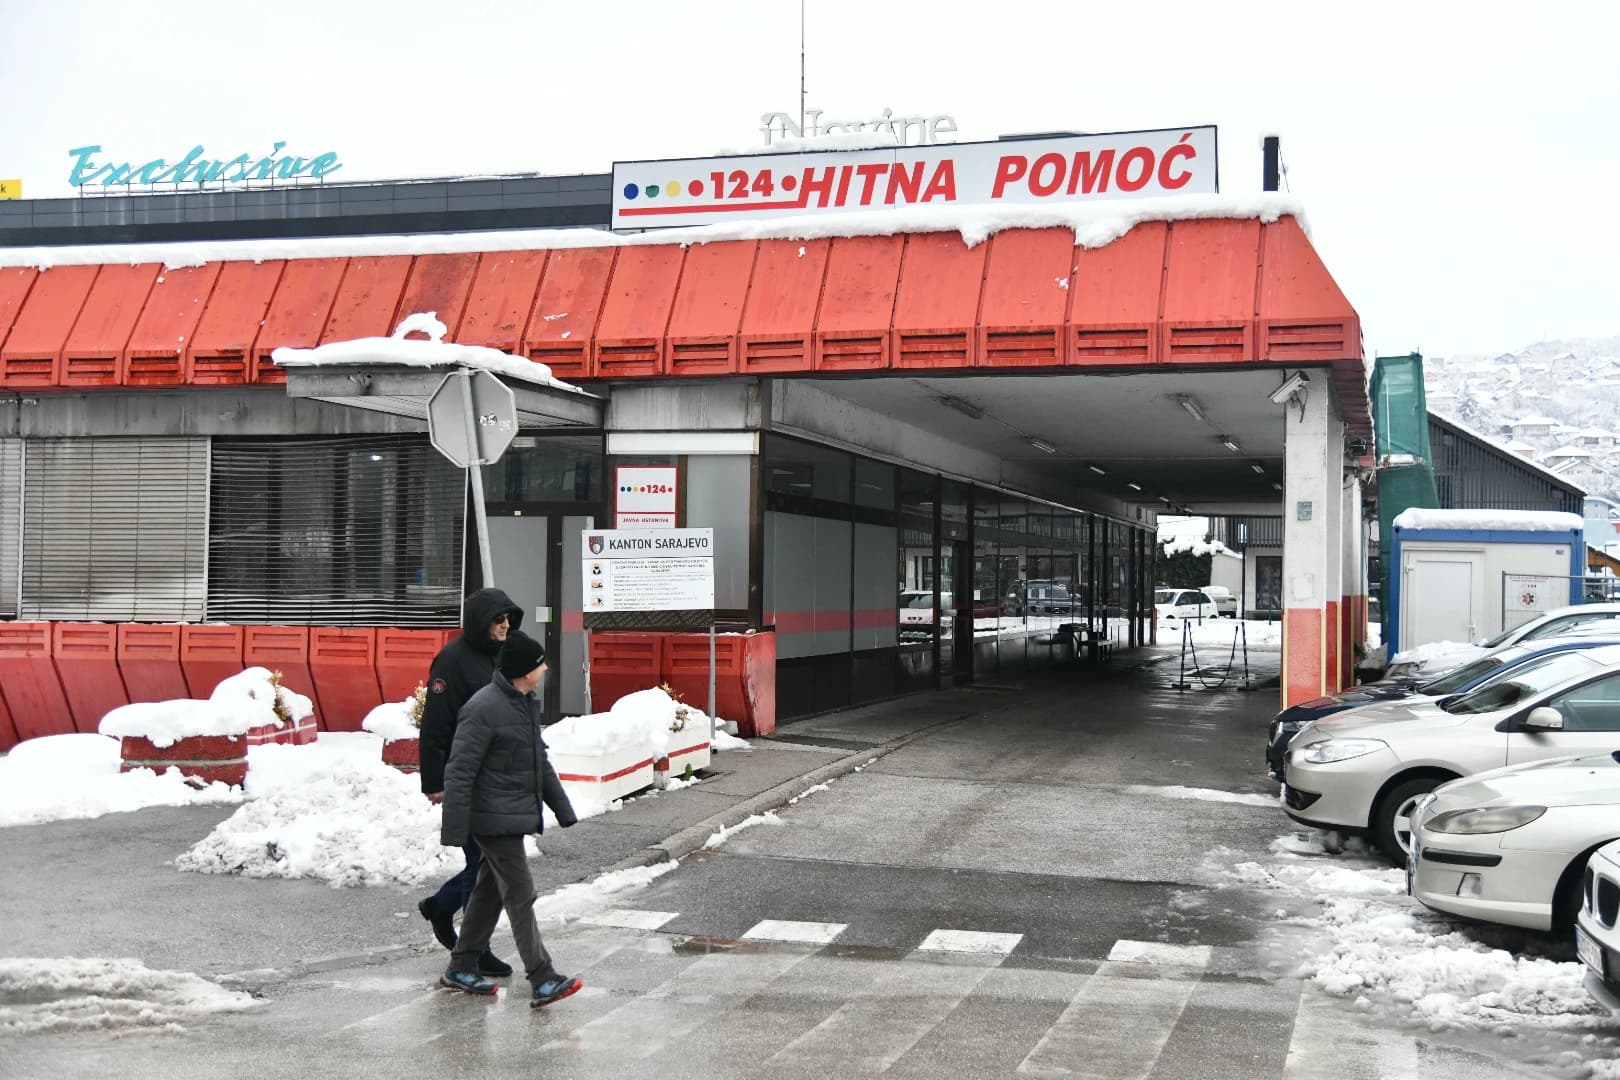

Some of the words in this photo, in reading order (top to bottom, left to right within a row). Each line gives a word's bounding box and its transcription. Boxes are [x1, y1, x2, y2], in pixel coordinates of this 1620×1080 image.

[68, 140, 343, 187] Exclusive
[710, 169, 775, 200] 124
[797, 159, 957, 209] HITNA
[991, 132, 1197, 199] POMOĆ
[646, 484, 667, 494] 124
[609, 538, 652, 550] KANTON
[655, 537, 708, 549] SARAJEVO
